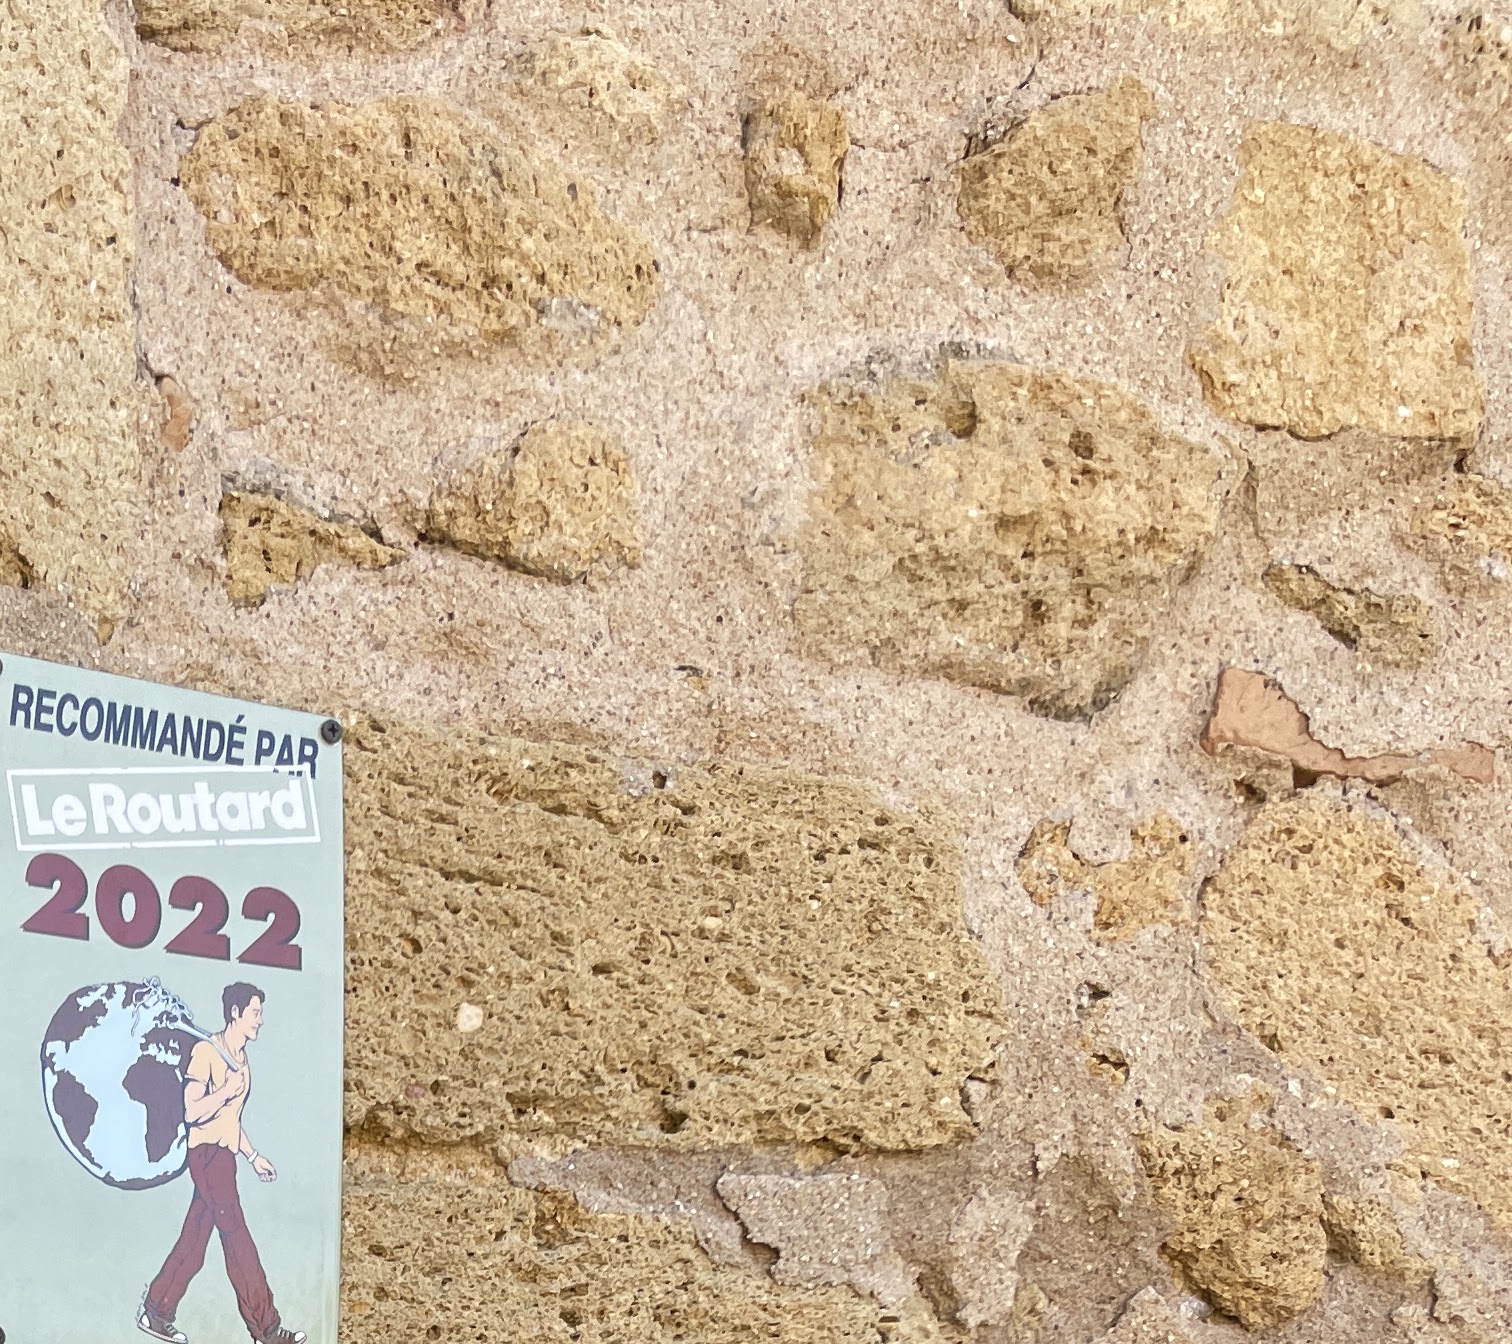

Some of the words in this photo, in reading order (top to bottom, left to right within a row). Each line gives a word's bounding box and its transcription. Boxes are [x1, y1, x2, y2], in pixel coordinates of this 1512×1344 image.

[9, 684, 247, 767] RECOMMANDÉ
[254, 729, 319, 779] PAR
[20, 852, 303, 971] 2022
